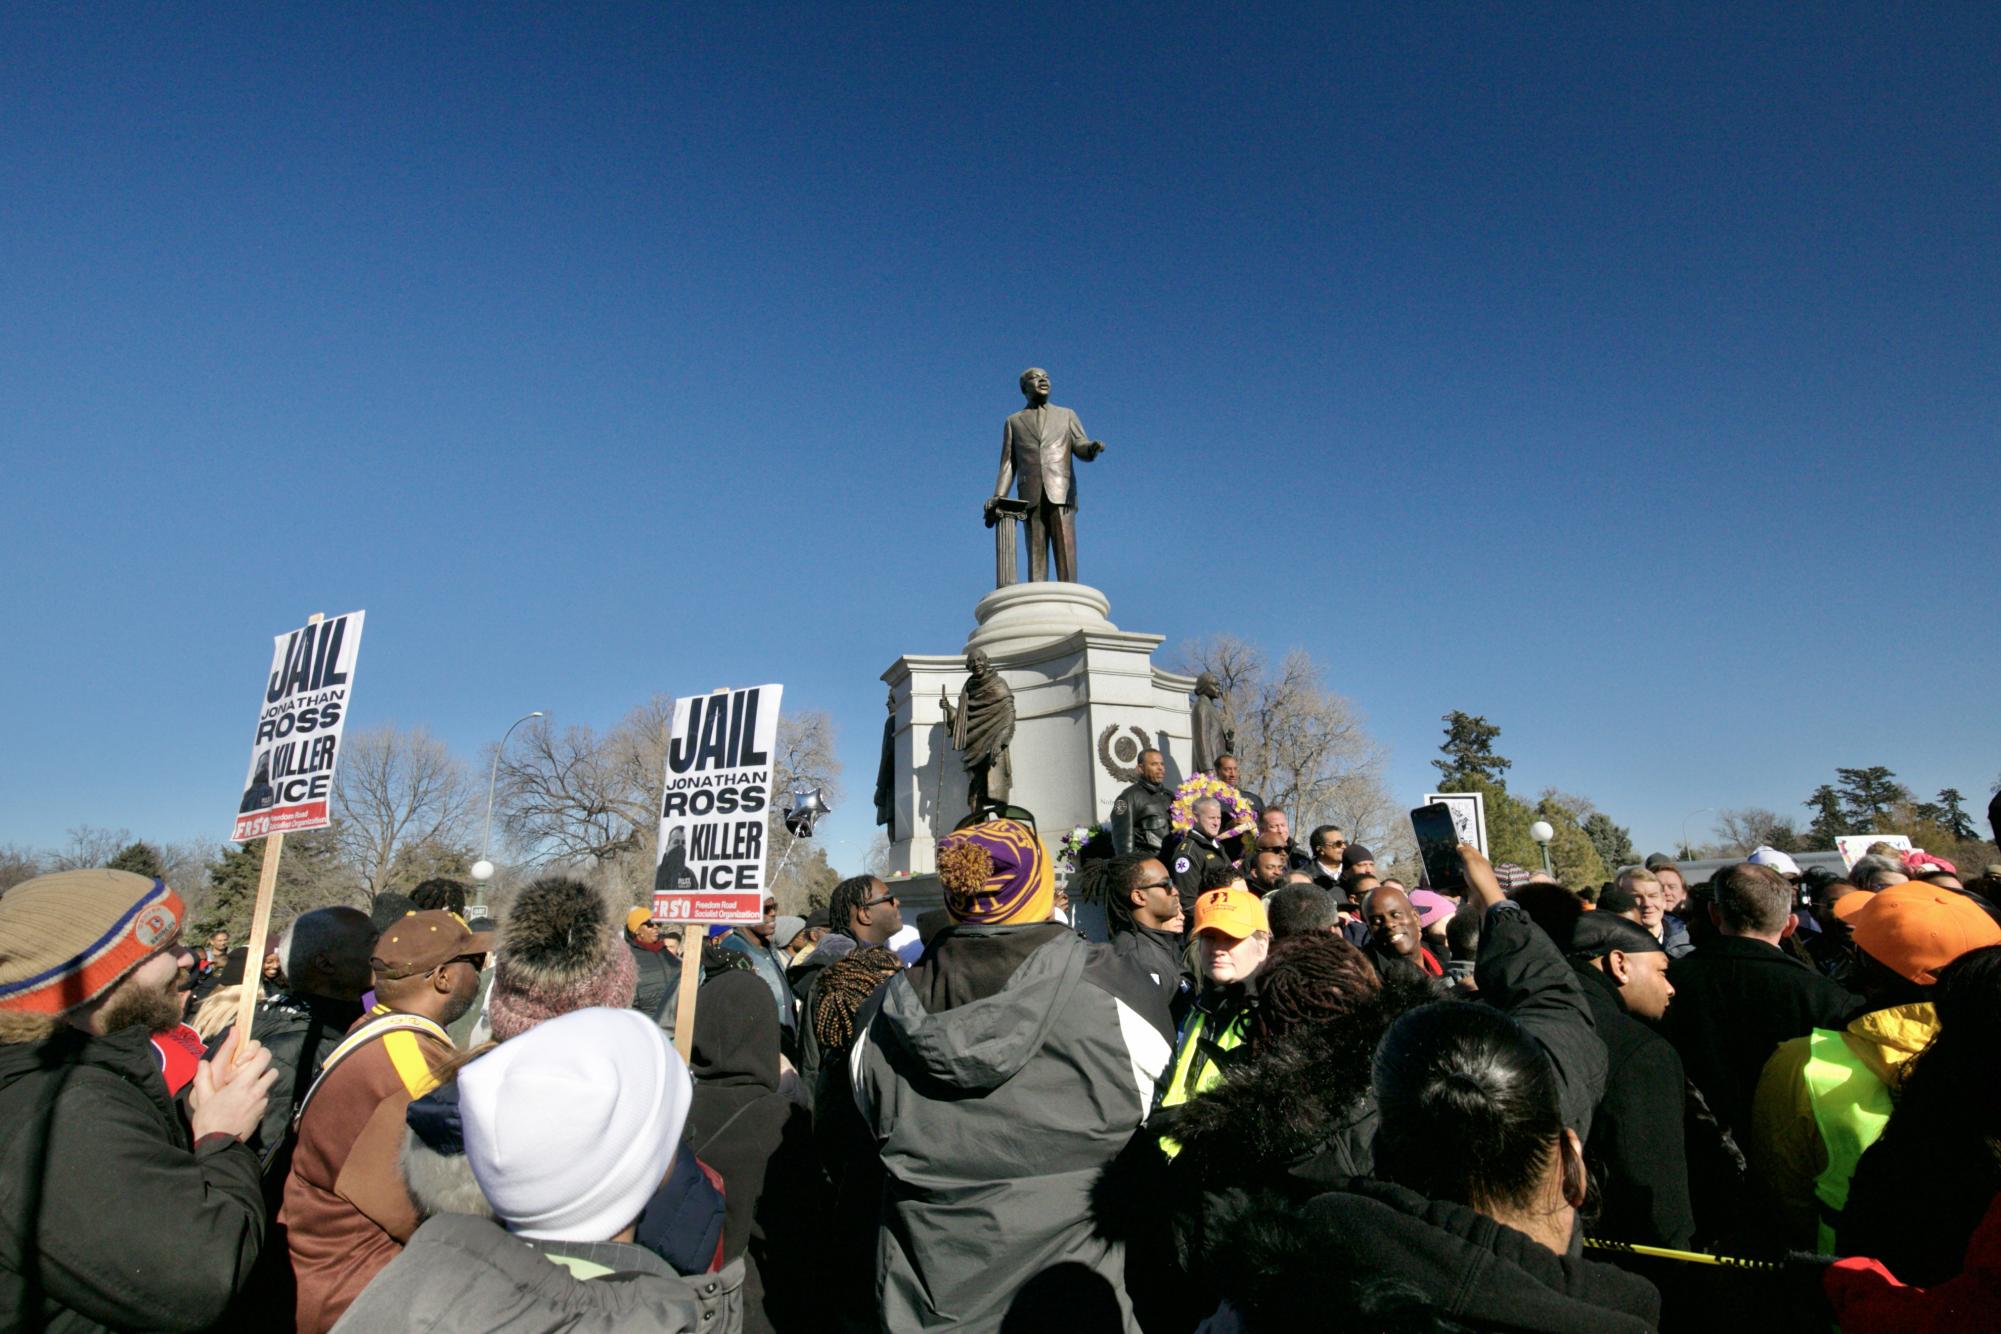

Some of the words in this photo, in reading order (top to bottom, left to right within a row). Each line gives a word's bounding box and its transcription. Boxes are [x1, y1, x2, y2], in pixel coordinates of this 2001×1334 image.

[267, 616, 347, 703] JAIL
[261, 690, 345, 720] JONATHAN
[256, 702, 341, 746] ROSS
[669, 688, 767, 773] JAIL
[272, 735, 335, 781] KILLER
[275, 775, 330, 804] ICE
[666, 771, 767, 790] JONATHAN
[663, 786, 765, 818] ROSS
[235, 816, 270, 839] FRSO
[690, 821, 763, 861] KILLER
[700, 865, 759, 890] ICE
[695, 901, 721, 909] Freedom
[722, 901, 737, 909] Road
[695, 910, 718, 918] Socialist
[718, 910, 761, 920] Organization
